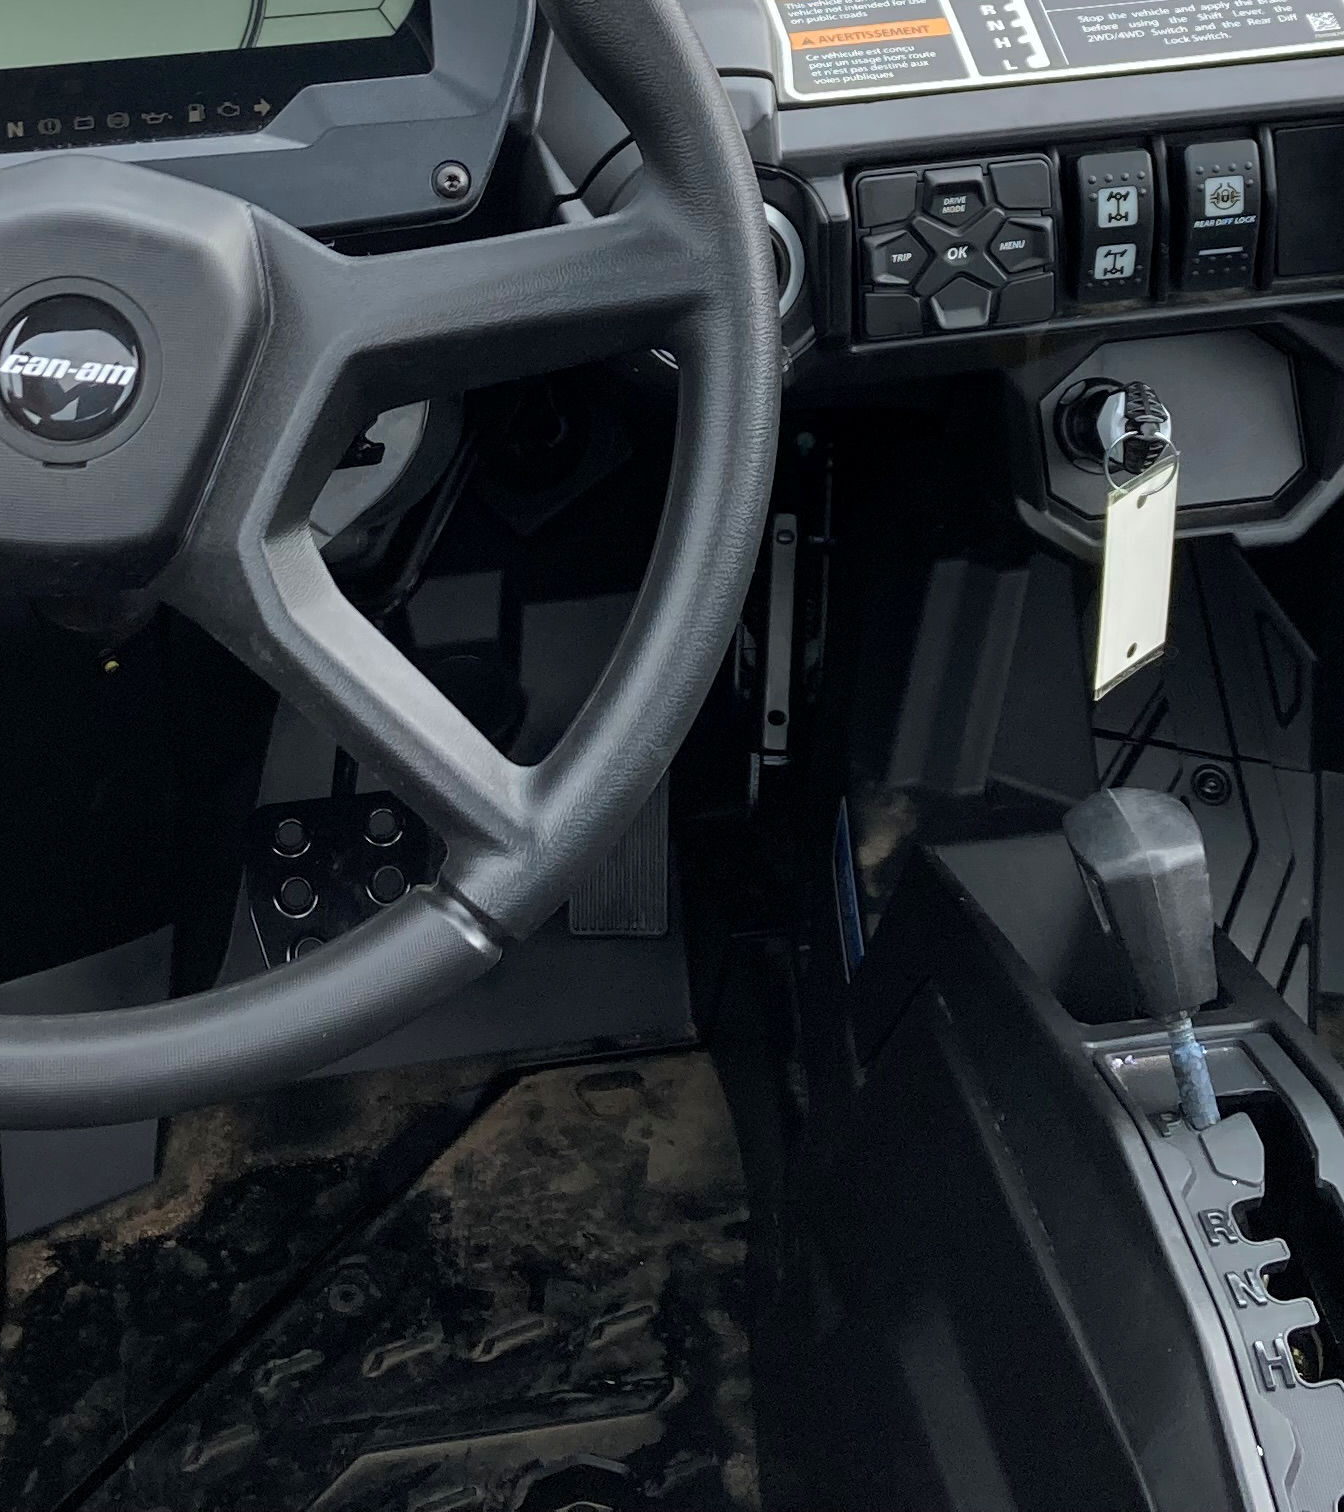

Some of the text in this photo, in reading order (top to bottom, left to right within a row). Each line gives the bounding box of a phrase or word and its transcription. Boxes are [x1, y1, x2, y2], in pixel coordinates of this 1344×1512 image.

[980, 5, 997, 16] R
[986, 20, 1005, 32] N
[818, 24, 932, 44] AVERTISSEMENT
[994, 37, 1012, 49] H
[1002, 59, 1018, 71] L
[7, 121, 24, 138] N
[943, 195, 967, 206] DRIVE
[942, 204, 966, 214] MODE
[1193, 214, 1256, 229] REAR DIFF LOCK
[999, 239, 1026, 252] MENU
[891, 251, 913, 264] TRIP
[947, 245, 968, 261] OK
[0, 354, 137, 386] can-am
[1197, 1209, 1238, 1246] R
[1225, 1268, 1267, 1308] N
[1253, 1337, 1296, 1391] H
